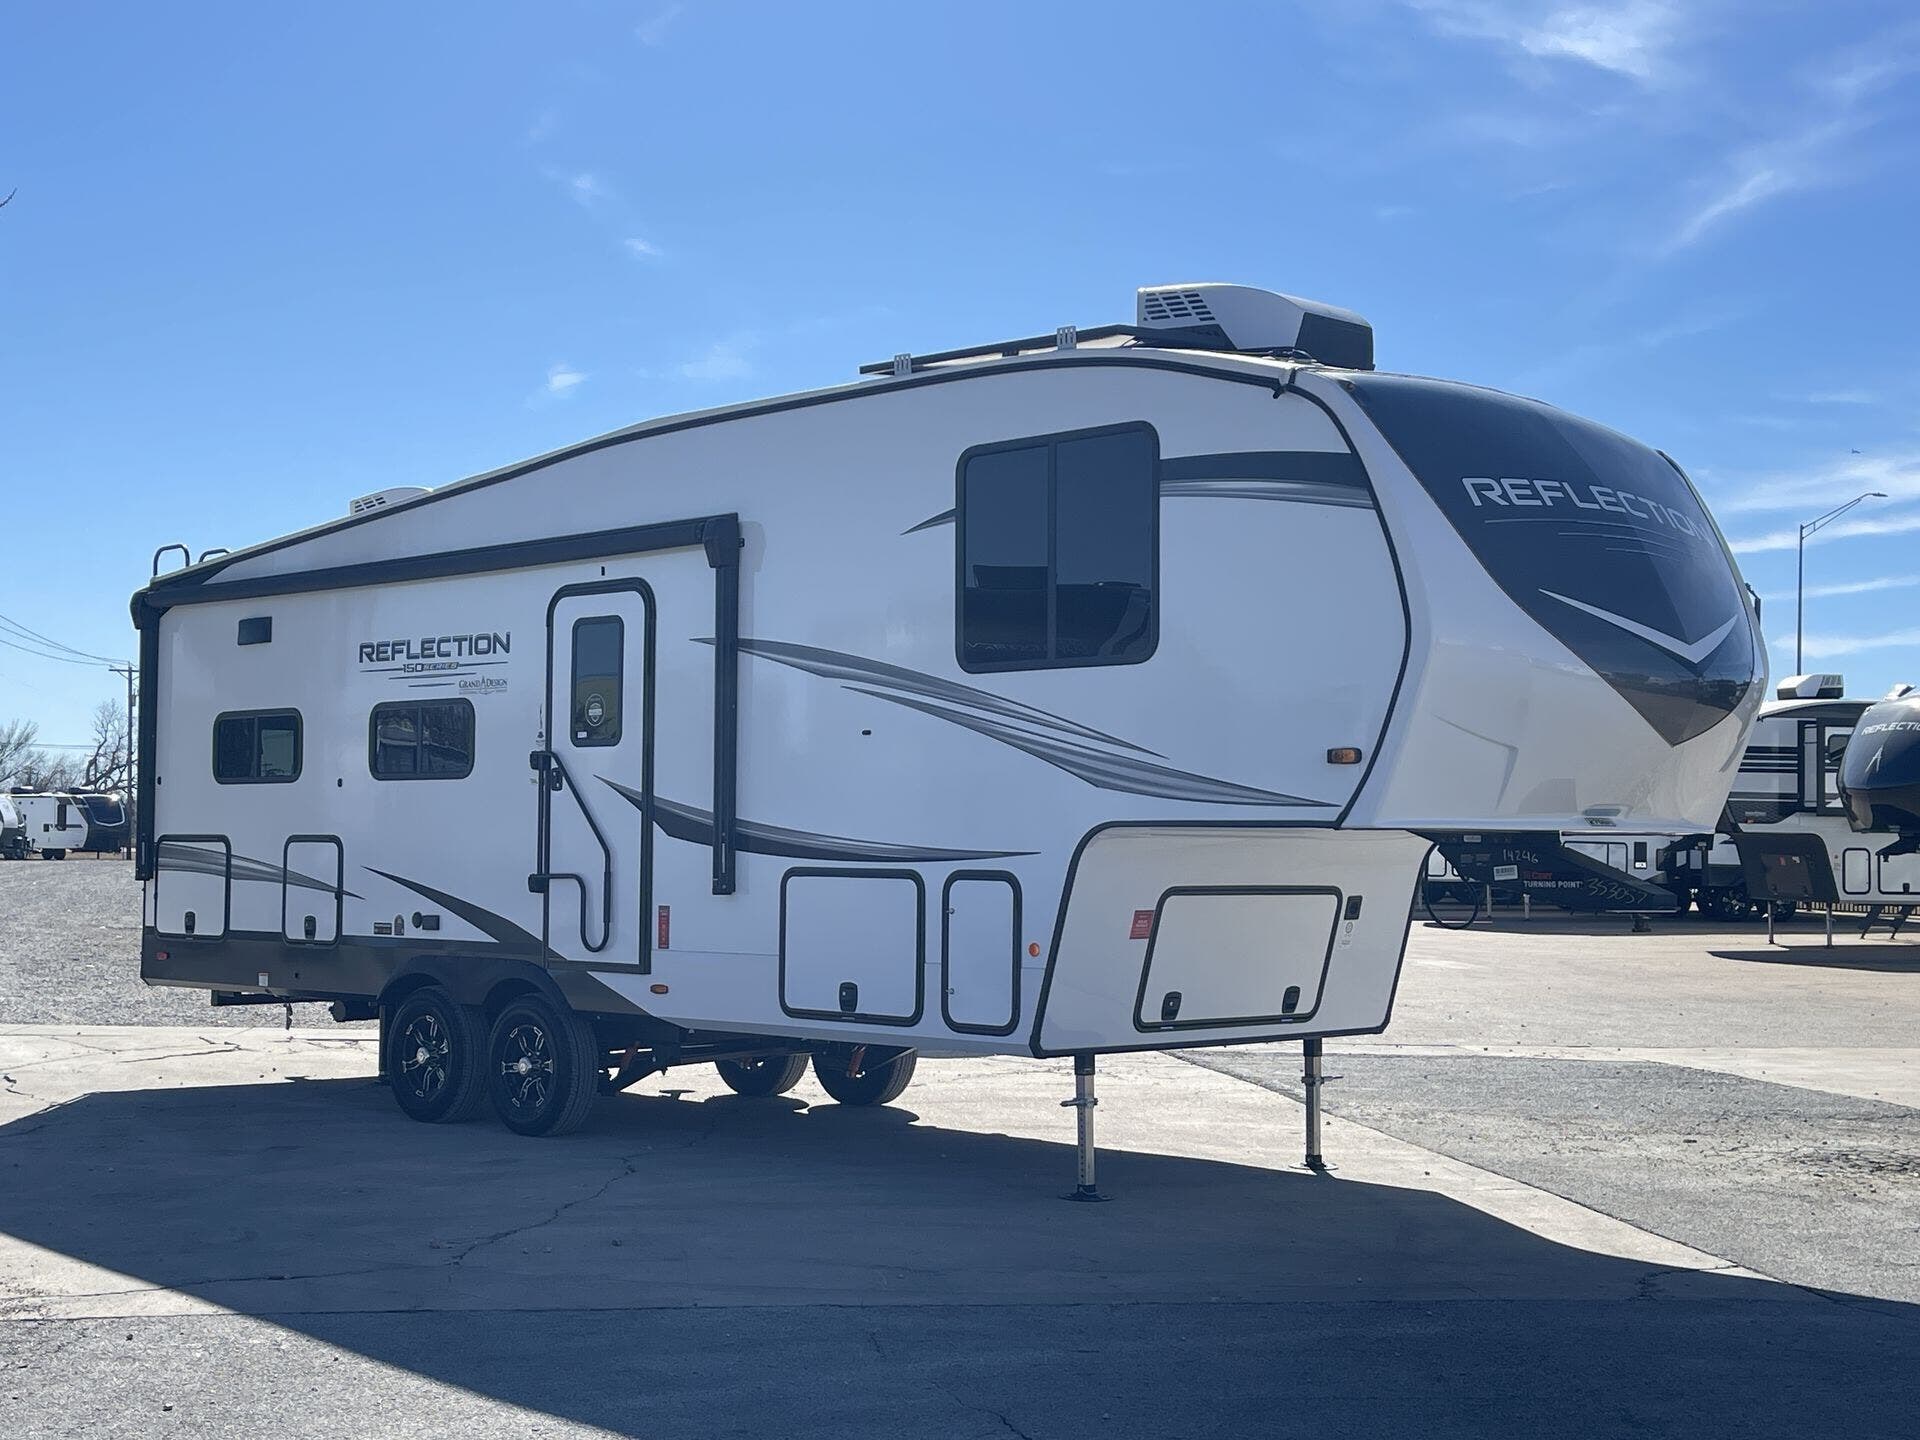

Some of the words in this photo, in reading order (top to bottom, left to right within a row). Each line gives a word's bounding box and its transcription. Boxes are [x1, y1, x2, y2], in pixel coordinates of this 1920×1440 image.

[1461, 477, 1714, 548] REFLECTION
[358, 631, 511, 663] REFLECTION
[1523, 880, 1557, 889] TURNING
